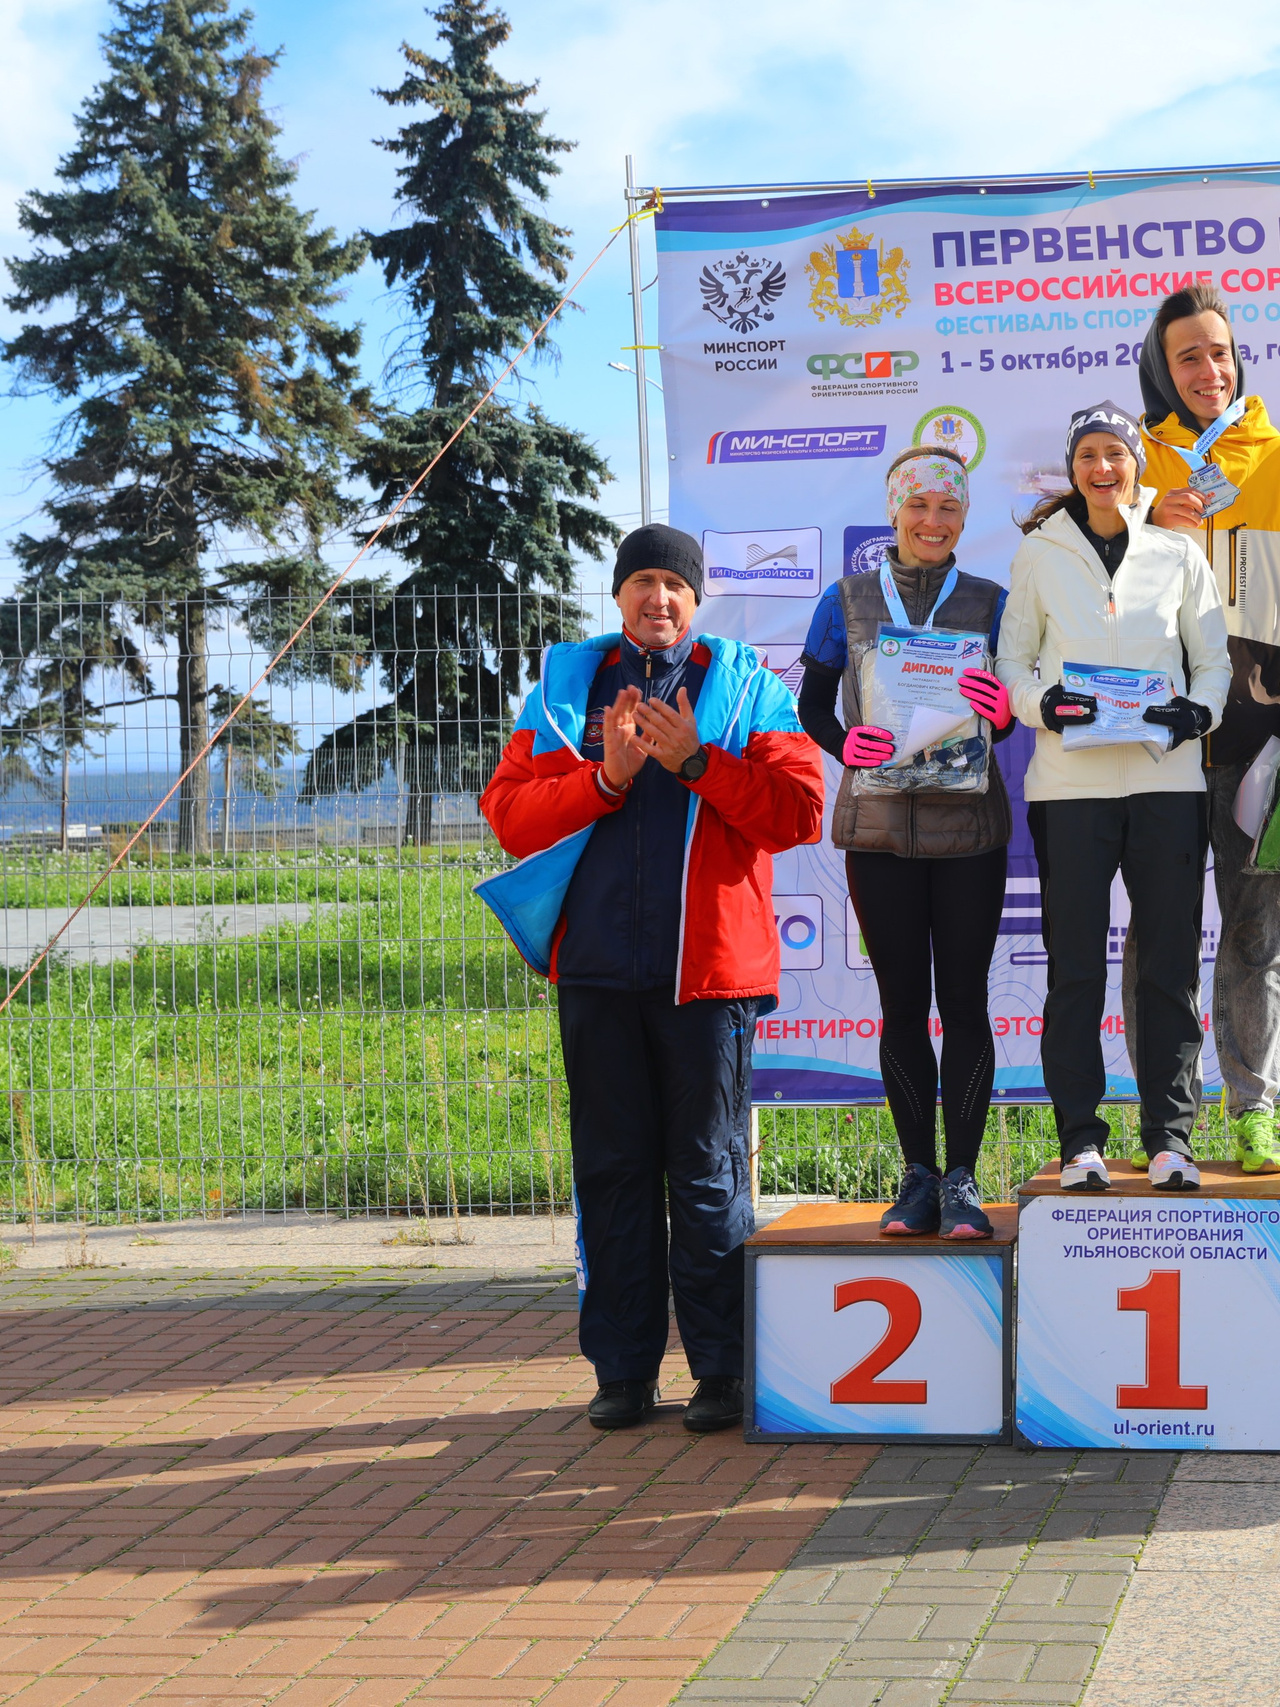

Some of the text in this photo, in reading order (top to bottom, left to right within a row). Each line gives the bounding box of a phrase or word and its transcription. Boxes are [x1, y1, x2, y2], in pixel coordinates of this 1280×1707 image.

[932, 217, 1266, 268] ПЕРВЕНСТВО
[935, 310, 1079, 337] ФЕСТИВАЛЬ
[703, 339, 786, 355] МИНСПОРТ
[714, 357, 779, 372] РОССИИ
[941, 350, 955, 374] 1
[978, 348, 995, 373] 5
[1001, 344, 1109, 375] октября
[811, 380, 919, 392] ФЕДЕРАЦИЯ СПОРТИВНОГО
[811, 387, 919, 398] ОРИЕНТИРОВАНИЯ РОССИИ
[730, 430, 879, 451] МИНСПОРТ
[1065, 410, 1138, 456] CRAFT
[1239, 556, 1247, 588] PROTEST
[913, 638, 955, 649] МИНСПОРТ
[901, 661, 954, 677] ДИПЛОМ
[1096, 675, 1138, 685] МИНСПОРТ
[1062, 694, 1095, 703] VICTORY
[1093, 692, 1141, 710] ДИПЛОМ
[994, 1016, 1044, 1036] ЭТО
[1051, 1208, 1280, 1225] ФЕДЕРАЦИЯ СПОРТИВНОГО
[1086, 1227, 1244, 1242] ОРИЕНТИРОВАНИЯ
[1063, 1242, 1268, 1260] УЛЬЯНОВСКОЙ ОБЛАСТИ
[829, 1275, 928, 1405] 2
[1115, 1268, 1208, 1410] 1
[1113, 1418, 1216, 1438] ul-orient.ru
